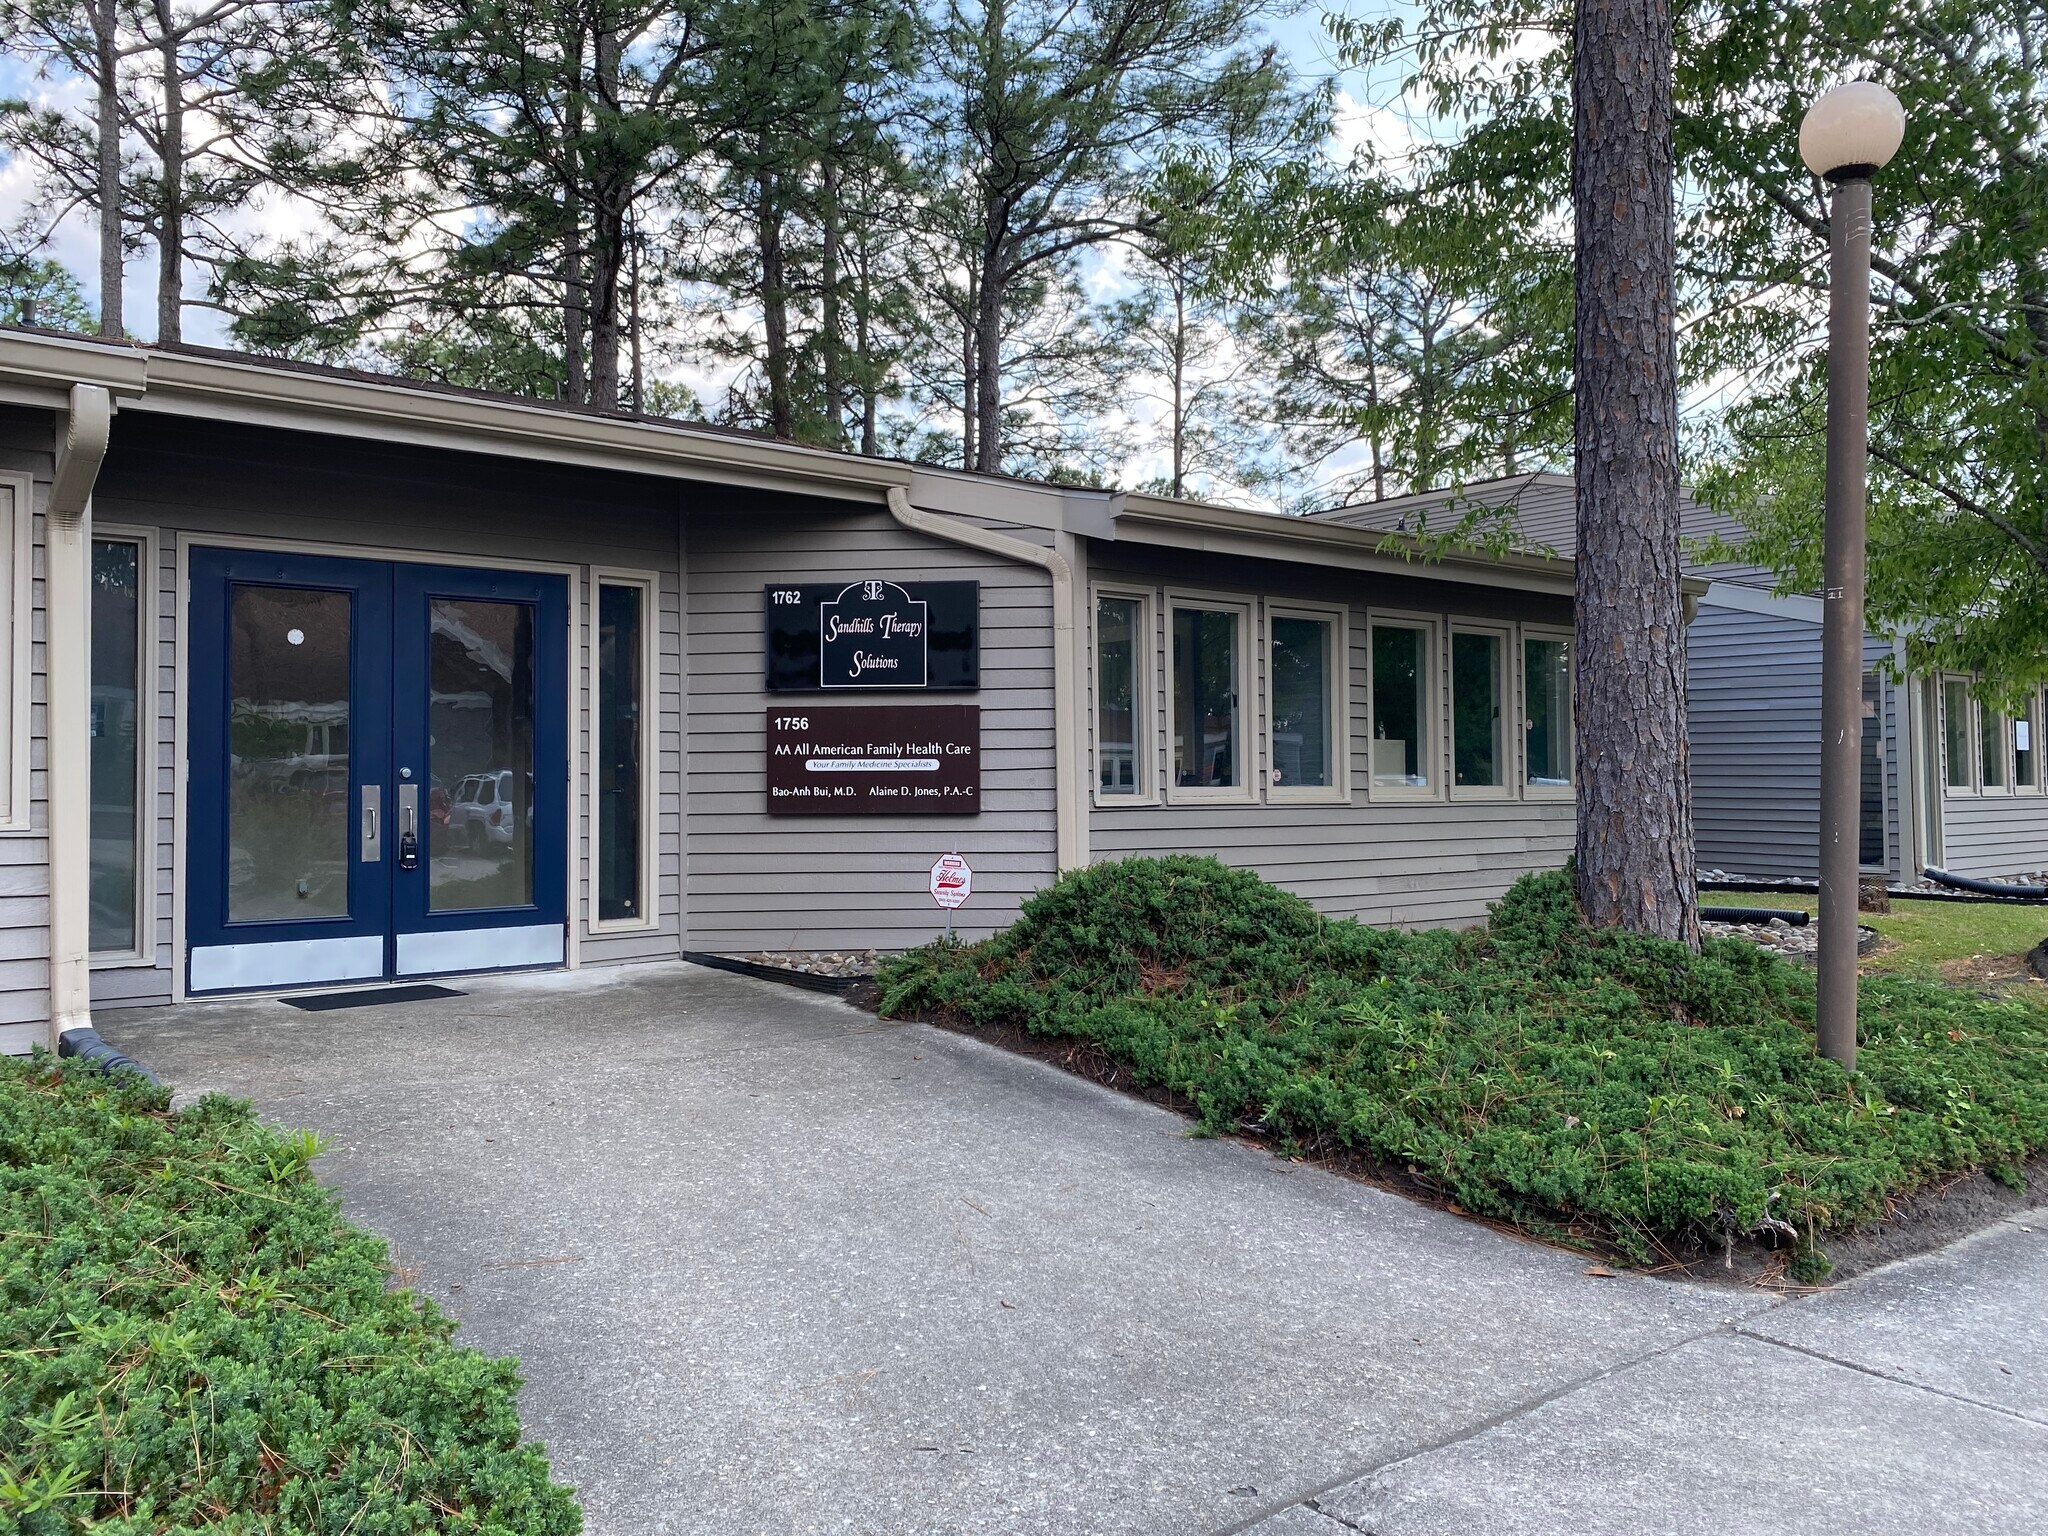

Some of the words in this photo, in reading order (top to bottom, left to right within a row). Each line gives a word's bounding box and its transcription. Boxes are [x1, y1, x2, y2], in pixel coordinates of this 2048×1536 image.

[772, 591, 800, 604] 1762
[826, 615, 874, 642] Sandhills
[879, 612, 922, 639] Therapy
[849, 650, 898, 677] Solutions
[774, 717, 809, 730] 1756
[775, 746, 791, 755] AA
[794, 743, 809, 755] All
[813, 743, 863, 755] American
[867, 743, 903, 757] Family
[906, 743, 942, 754] Health
[946, 743, 971, 754] Care
[831, 761, 855, 770] Family
[894, 761, 932, 769] Specialists
[773, 787, 811, 796] Bao-Anh
[814, 787, 831, 797] Bui,
[834, 787, 856, 796] M.D.
[869, 786, 899, 796] Alaine
[902, 787, 911, 796] D.
[914, 787, 941, 798] Jones,
[944, 787, 973, 796] P.A.-C
